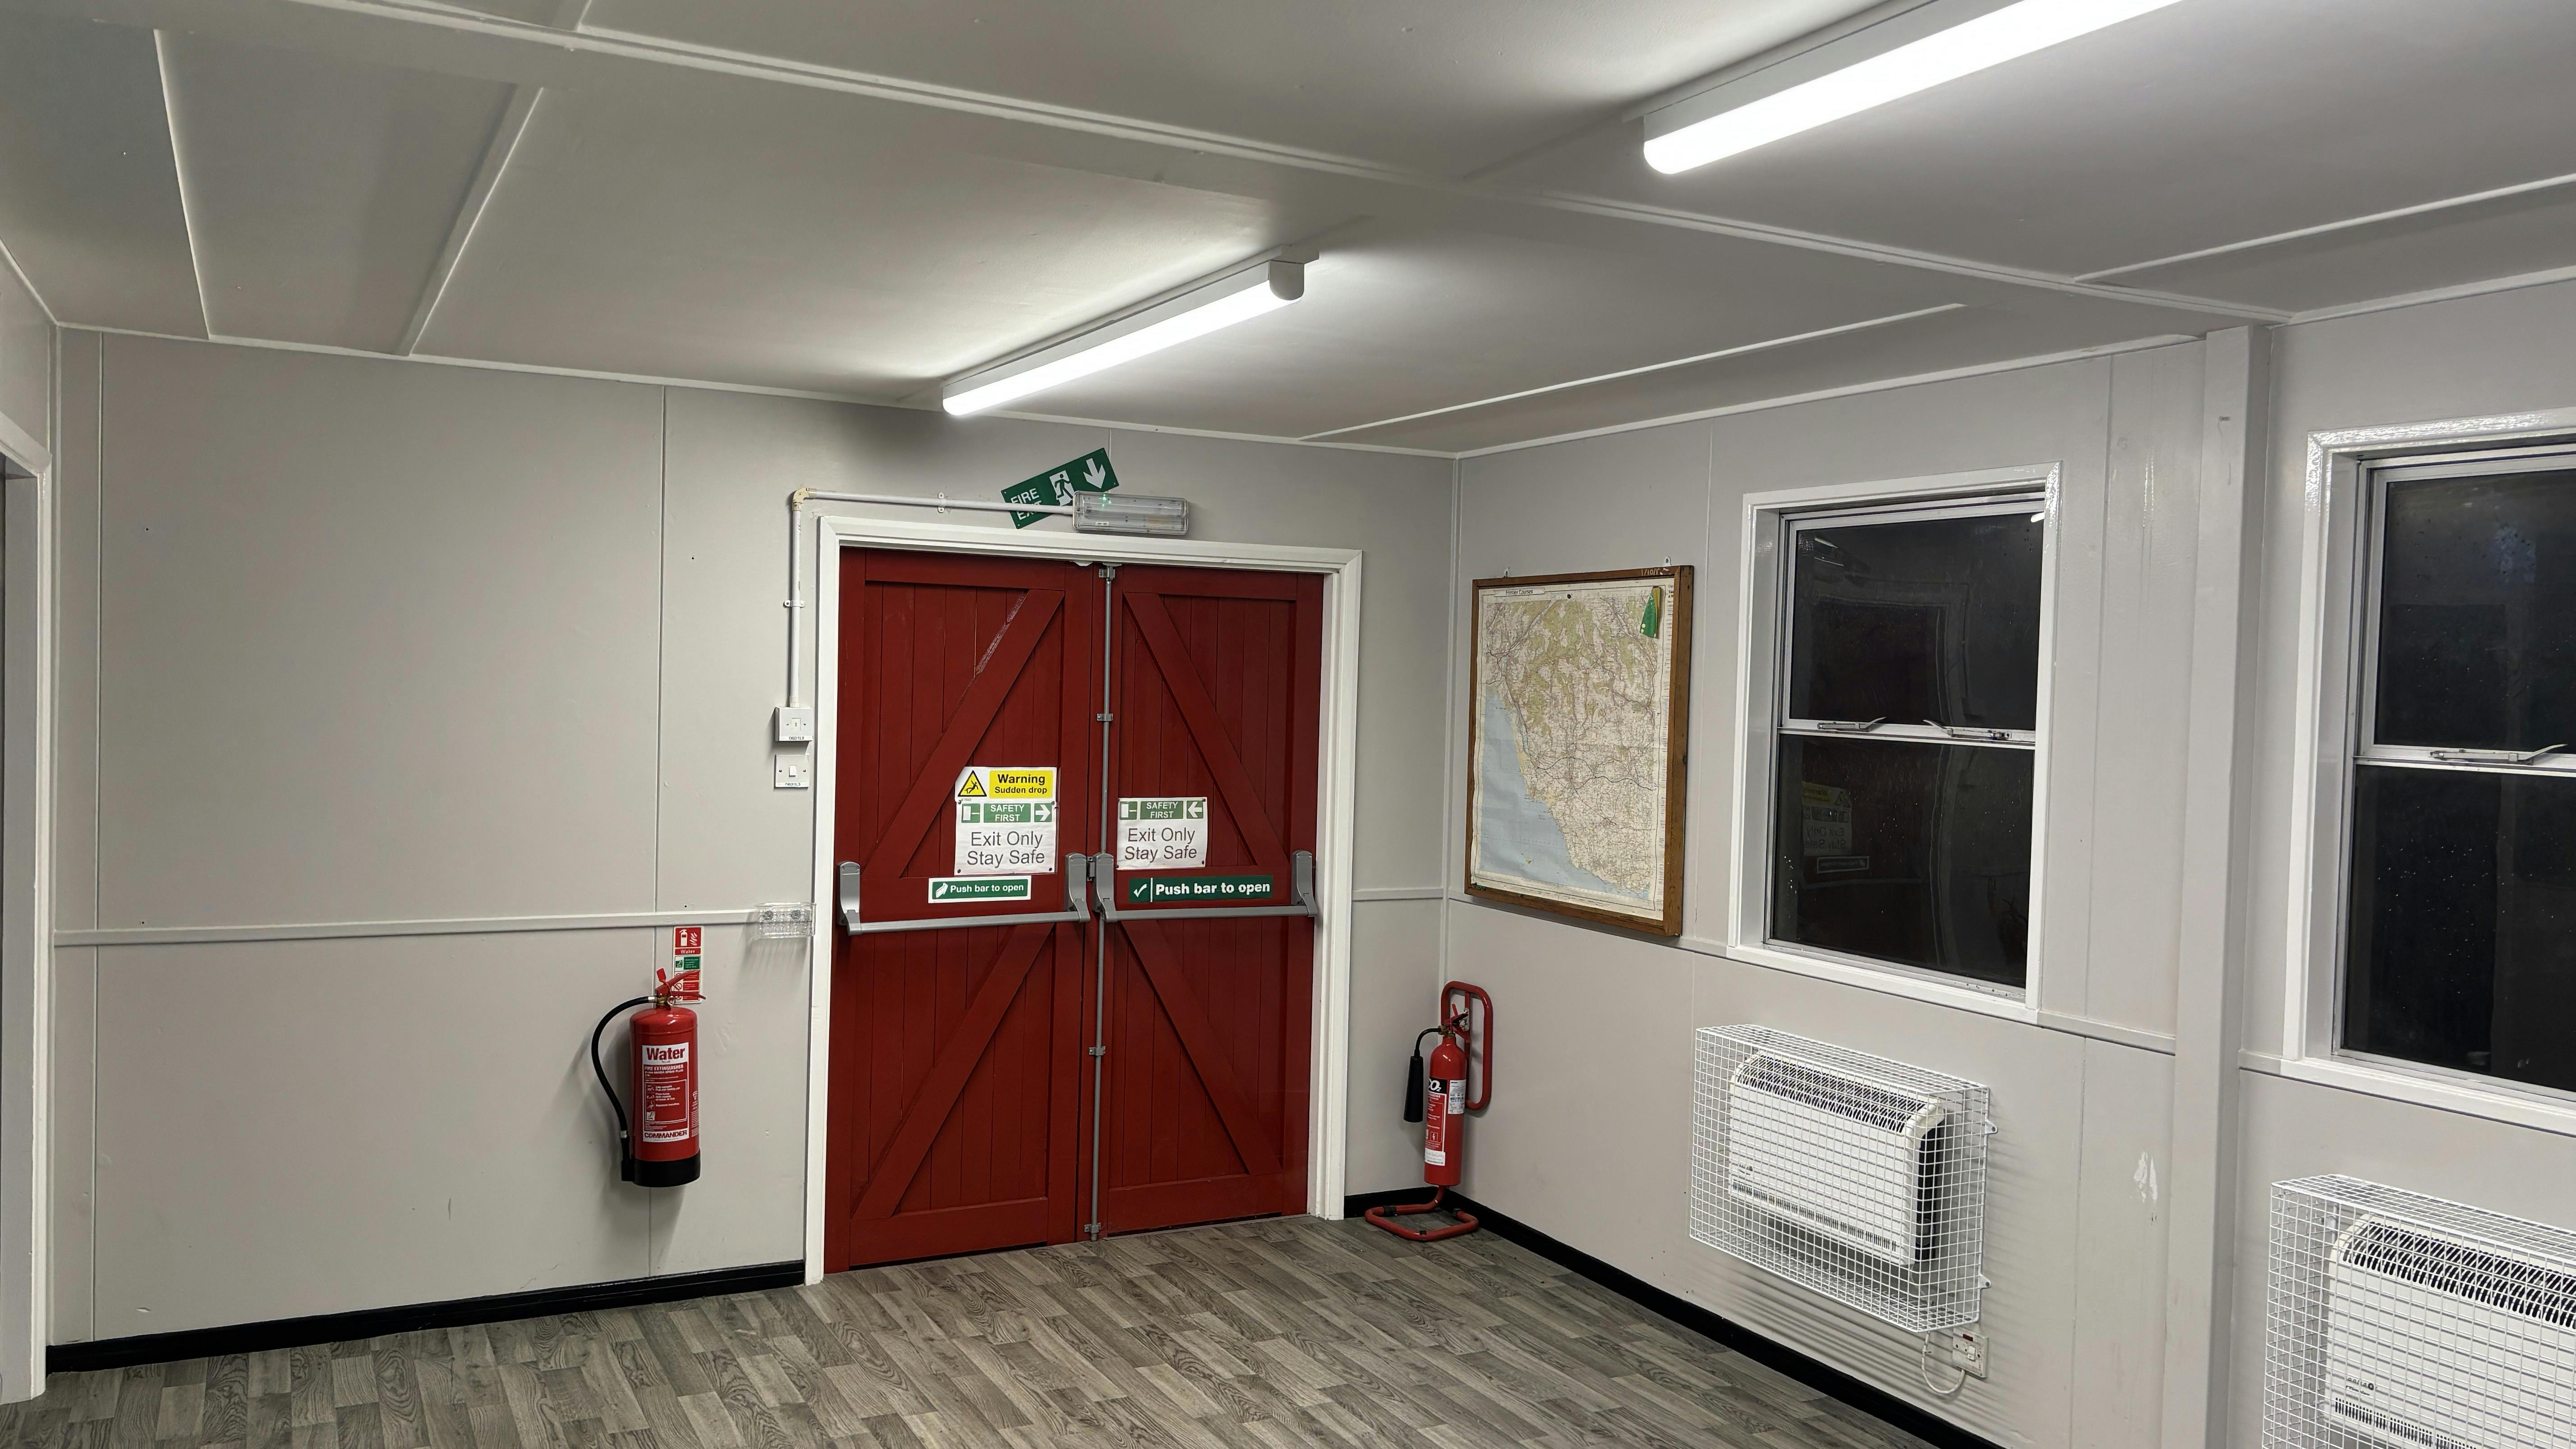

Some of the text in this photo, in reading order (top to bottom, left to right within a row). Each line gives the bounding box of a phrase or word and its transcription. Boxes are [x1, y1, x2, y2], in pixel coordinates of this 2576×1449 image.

[997, 774, 1045, 786] Warning
[1028, 786, 1048, 795] drop
[990, 804, 1025, 812] SAFETY
[1146, 801, 1178, 810] SAFETY
[971, 831, 1043, 849] Exit Only
[1128, 827, 1196, 845] Exit Only
[967, 850, 1045, 869] Stay Safe
[1124, 845, 1197, 863] Stay Safe
[950, 885, 972, 893] Push
[1003, 884, 1024, 894] open
[1155, 883, 1270, 895] Push bar to open
[646, 1047, 685, 1061] Water
[644, 1130, 687, 1139] COMMANDER
